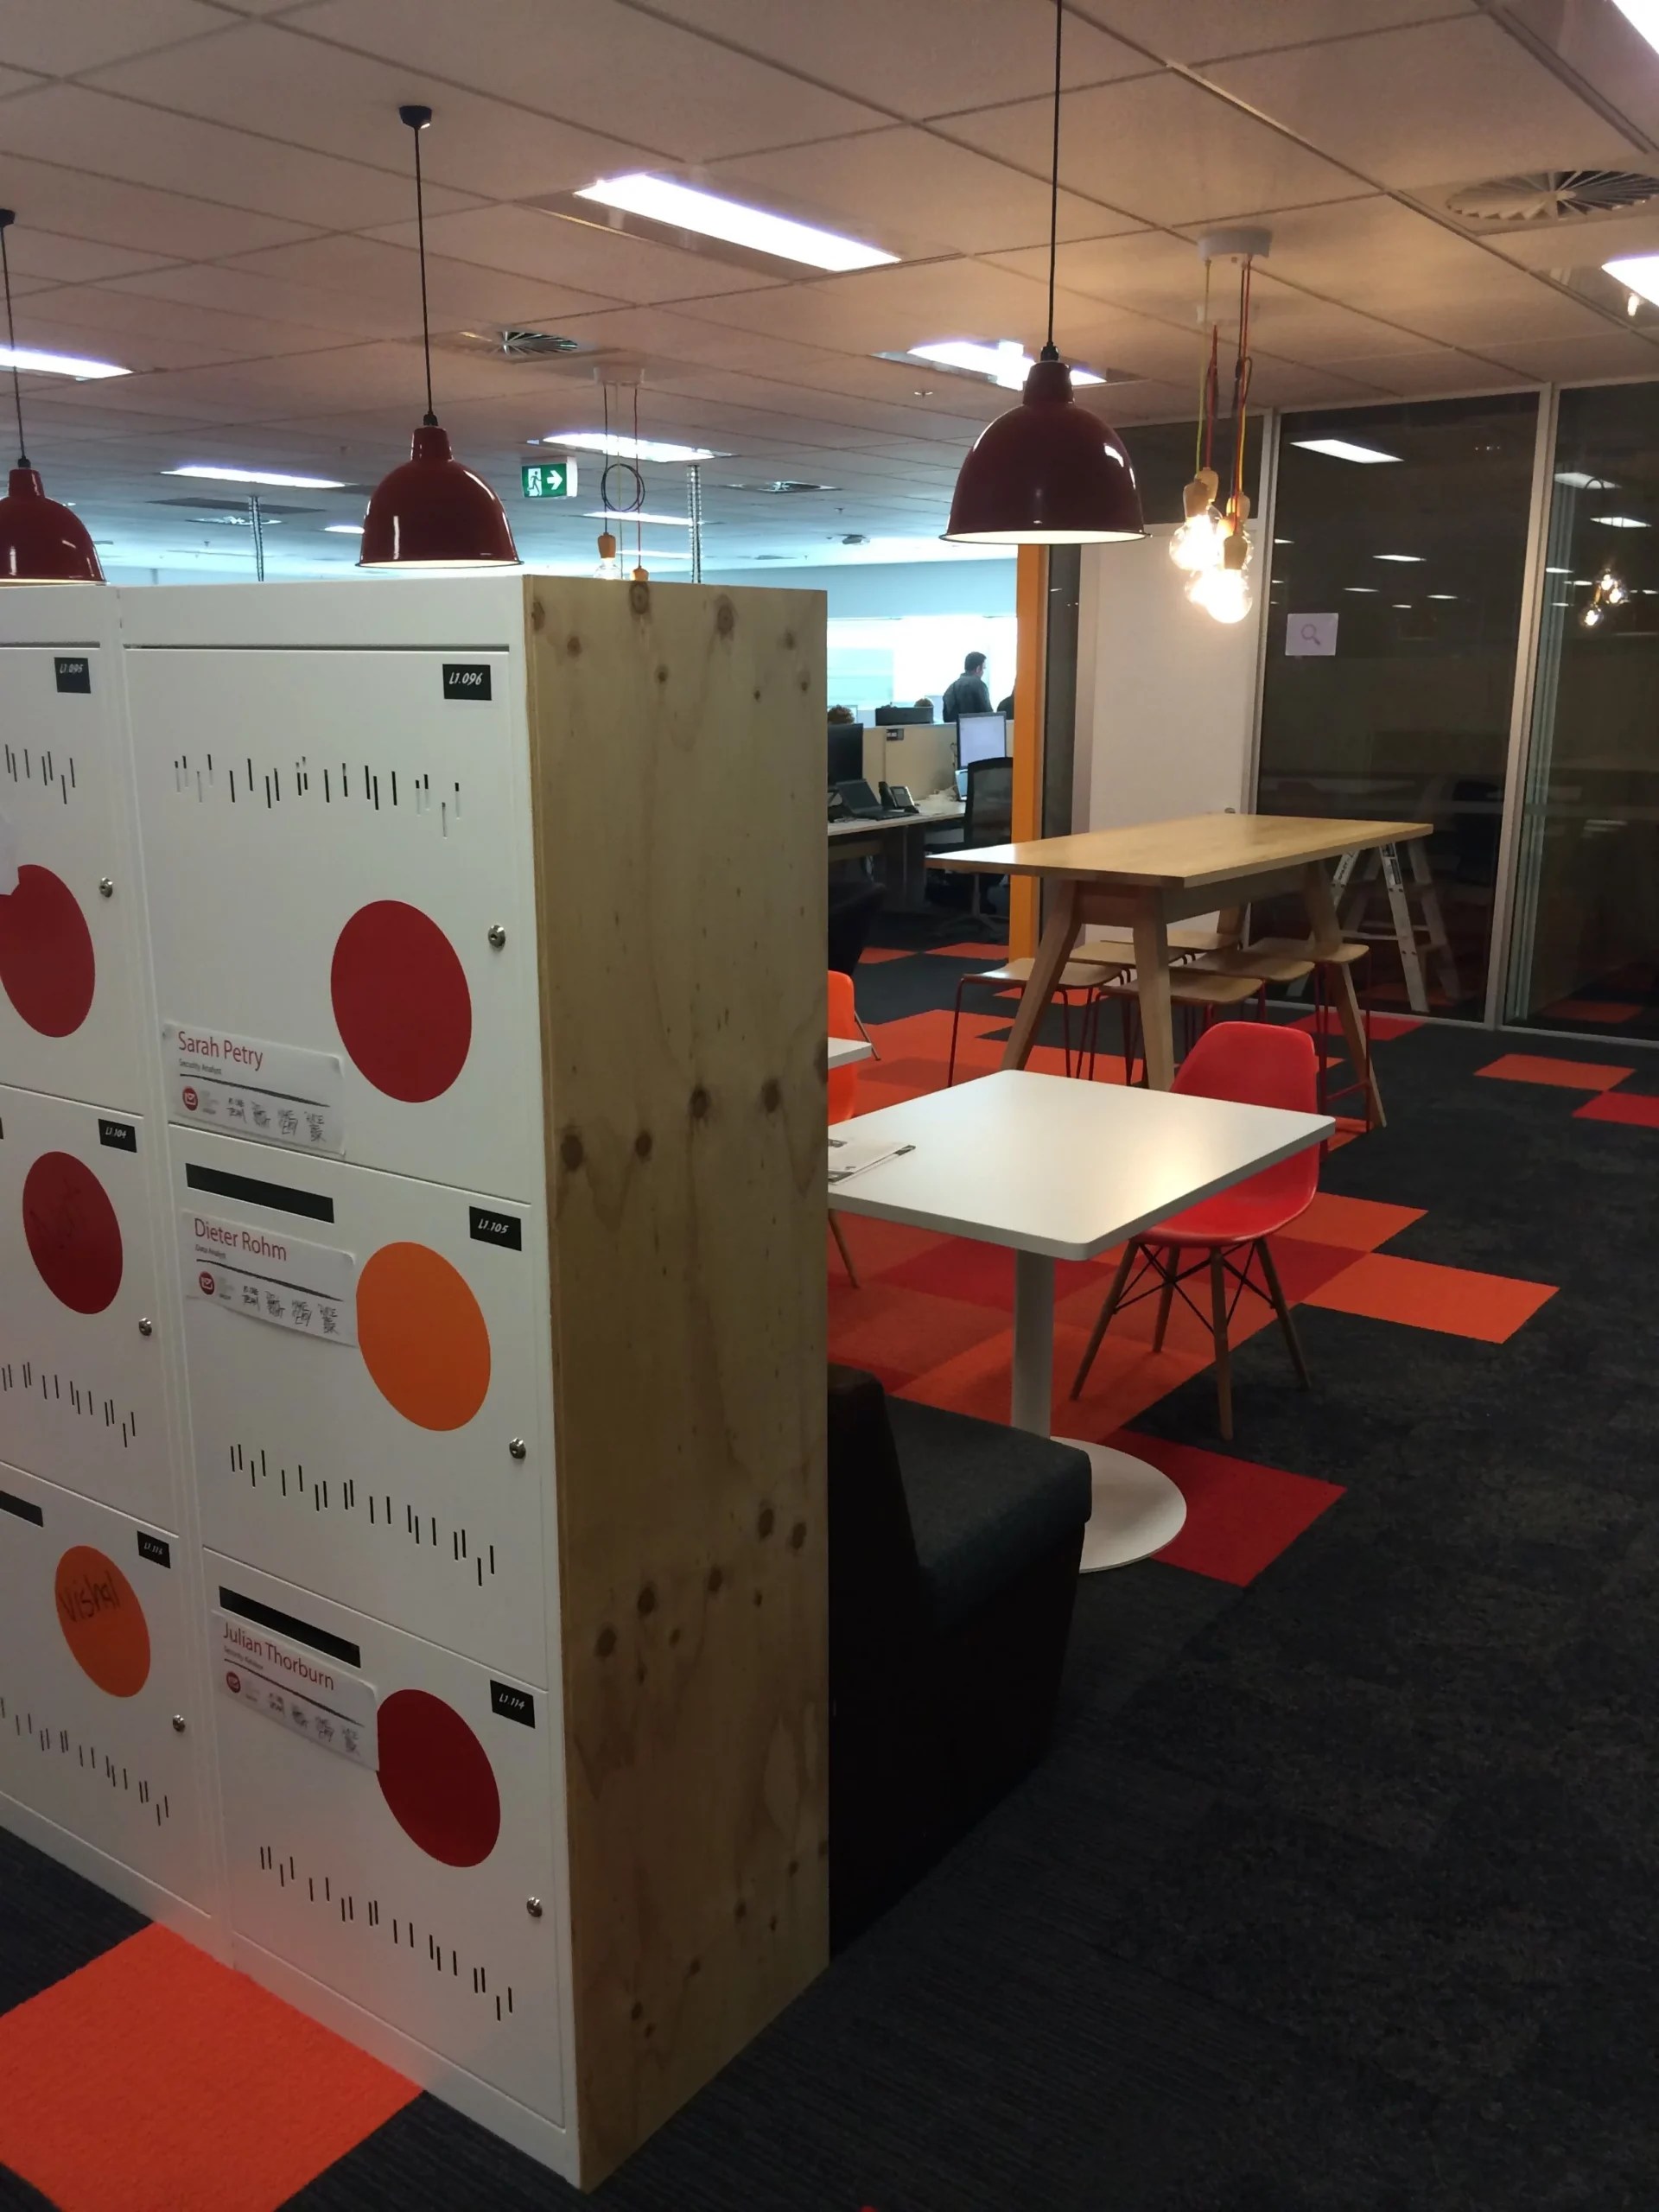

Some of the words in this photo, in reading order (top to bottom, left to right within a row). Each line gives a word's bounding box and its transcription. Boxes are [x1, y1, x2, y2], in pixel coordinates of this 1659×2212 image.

[178, 1030, 219, 1058] Sarah
[224, 1039, 264, 1071] Petry
[194, 1217, 238, 1247] Dieter
[242, 1231, 287, 1261] Rohm
[223, 1623, 262, 1656] Julian
[264, 1642, 334, 1690] Thorburn
